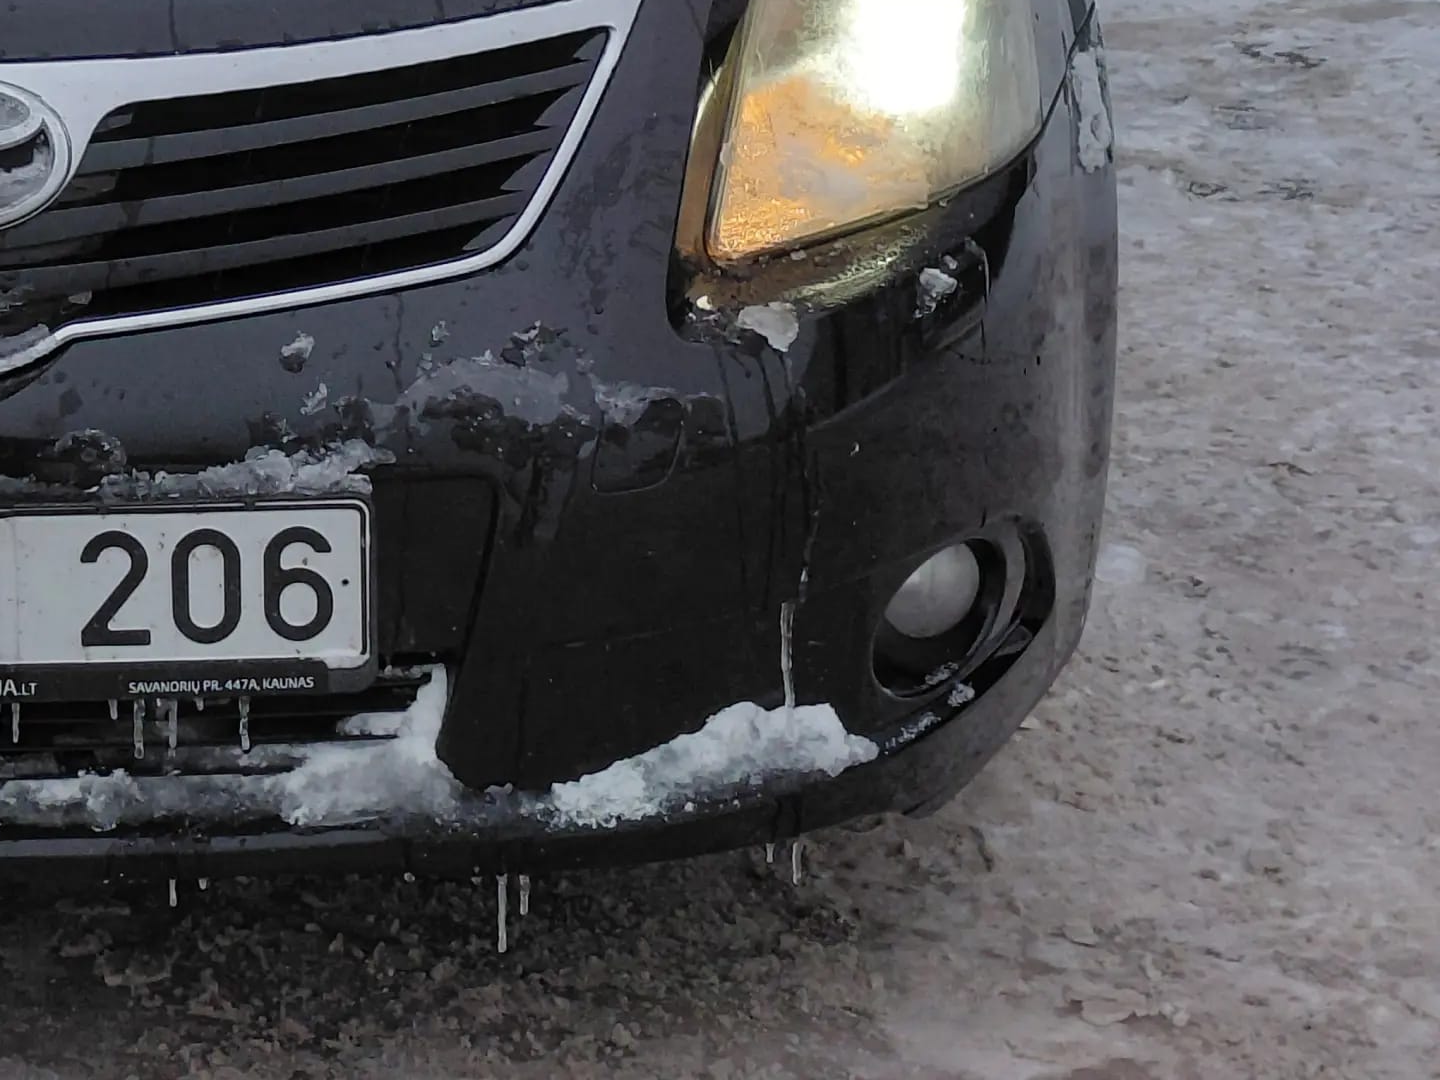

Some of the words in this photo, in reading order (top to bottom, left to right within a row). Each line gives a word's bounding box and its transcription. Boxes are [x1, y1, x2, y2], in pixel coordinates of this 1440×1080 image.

[79, 525, 334, 648] 206
[128, 679, 201, 695] SAVANORIŲ
[202, 679, 224, 692] PR.
[262, 676, 315, 690] KAUNAS
